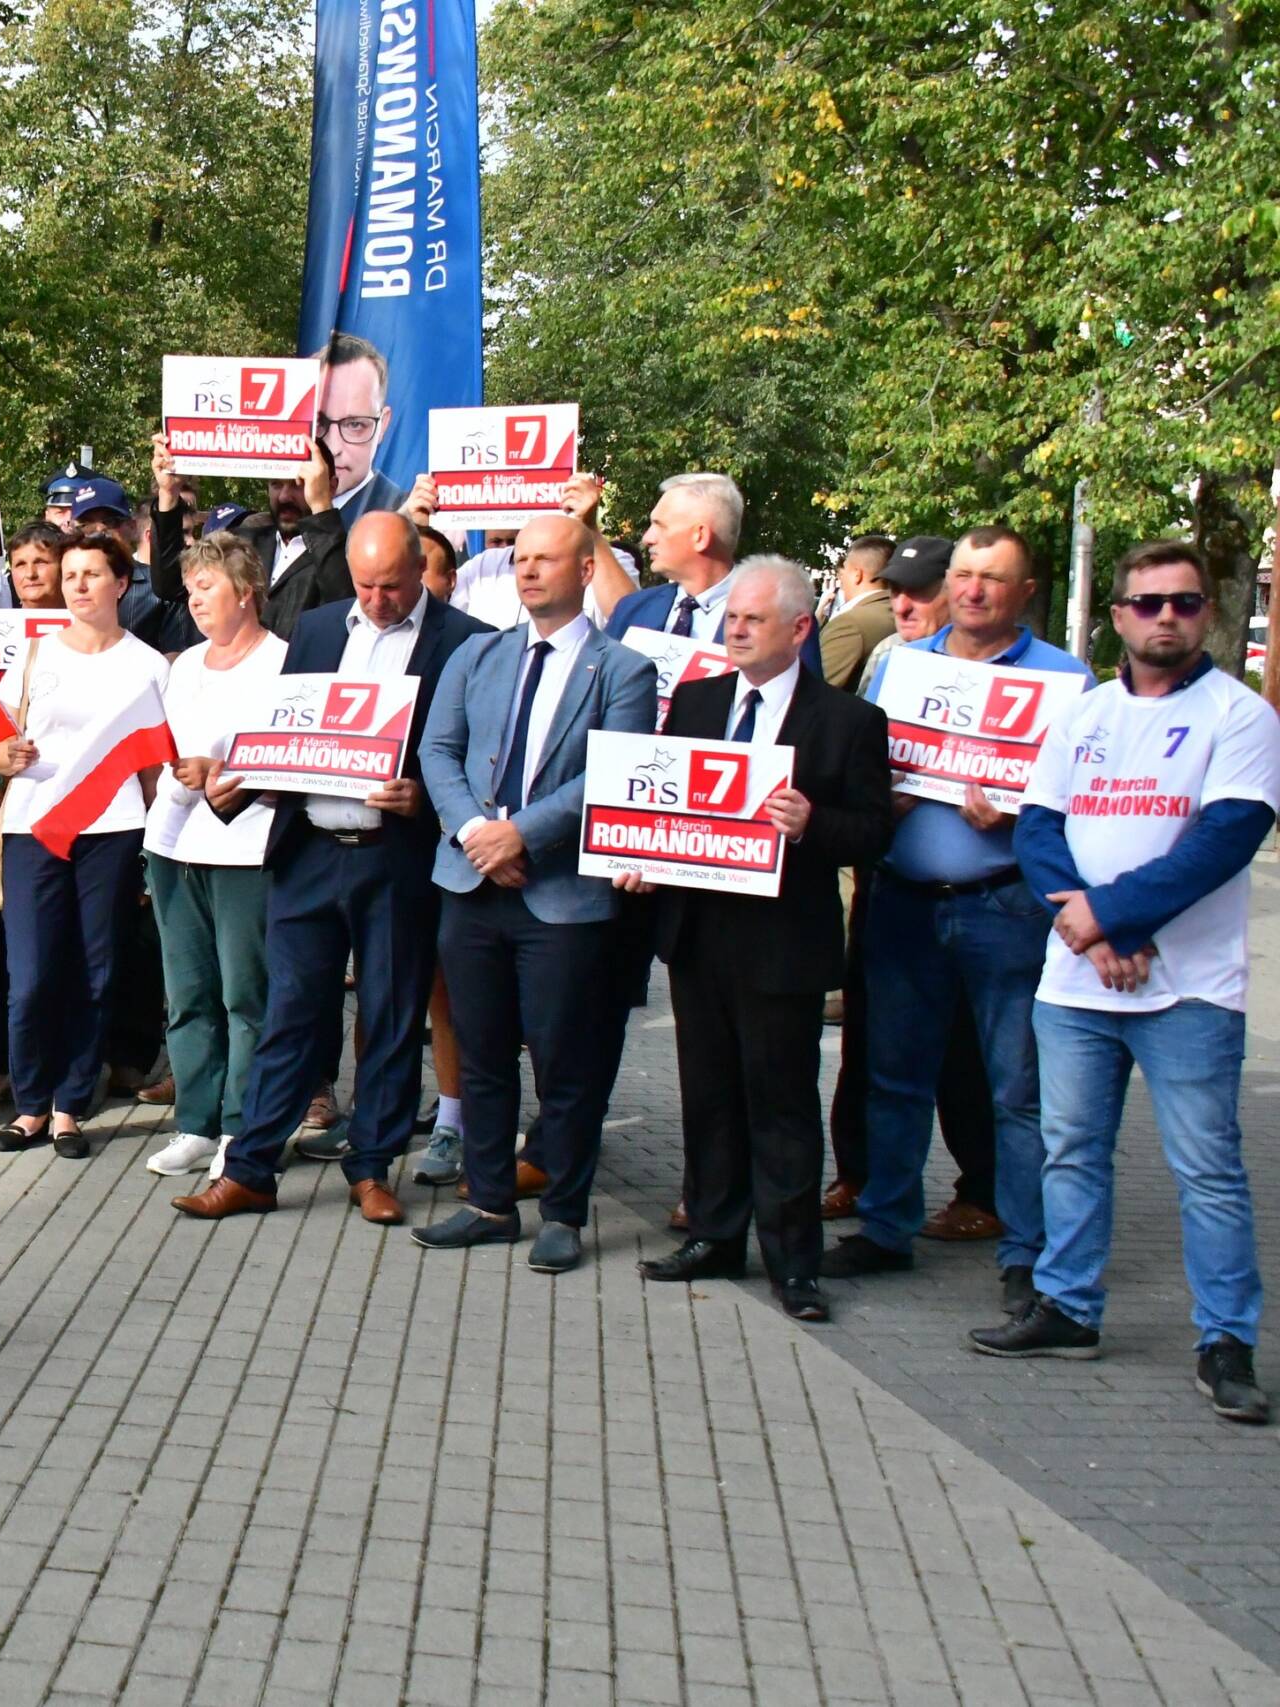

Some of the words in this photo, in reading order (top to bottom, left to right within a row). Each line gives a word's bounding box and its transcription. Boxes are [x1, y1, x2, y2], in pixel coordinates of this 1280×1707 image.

[194, 393, 233, 412] PiS
[244, 401, 255, 409] nr
[251, 373, 278, 410] 7
[216, 424, 226, 433] dr
[228, 424, 259, 433] Marcin
[170, 430, 305, 455] ROMANOWSKI
[461, 445, 498, 465] PiS
[509, 450, 520, 459] nr
[515, 421, 541, 459] 7
[495, 474, 524, 485] Marcin
[270, 708, 315, 727] PiS
[326, 715, 339, 724] nr
[338, 688, 370, 725] 7
[918, 697, 973, 727] PiS
[985, 715, 998, 726] nr
[998, 685, 1035, 729] 7
[288, 736, 301, 747] dr
[303, 737, 339, 749] Marcin
[942, 737, 956, 748] dr
[959, 739, 997, 755] Marcin
[1163, 726, 1191, 758] 7
[232, 745, 392, 775] ROMANOWSKI
[1074, 746, 1106, 764] PiS
[626, 778, 679, 805] PiS
[693, 791, 707, 803] nr
[703, 759, 739, 804] 7
[1090, 776, 1108, 791] dr
[1066, 794, 1191, 818] OMANOWSKI
[654, 818, 668, 829] dr
[671, 819, 711, 833] Marcin
[592, 822, 772, 864] ROMANOWSKI
[607, 859, 642, 871] Zawsze
[675, 868, 709, 880] zawsze
[711, 871, 726, 881] dla
